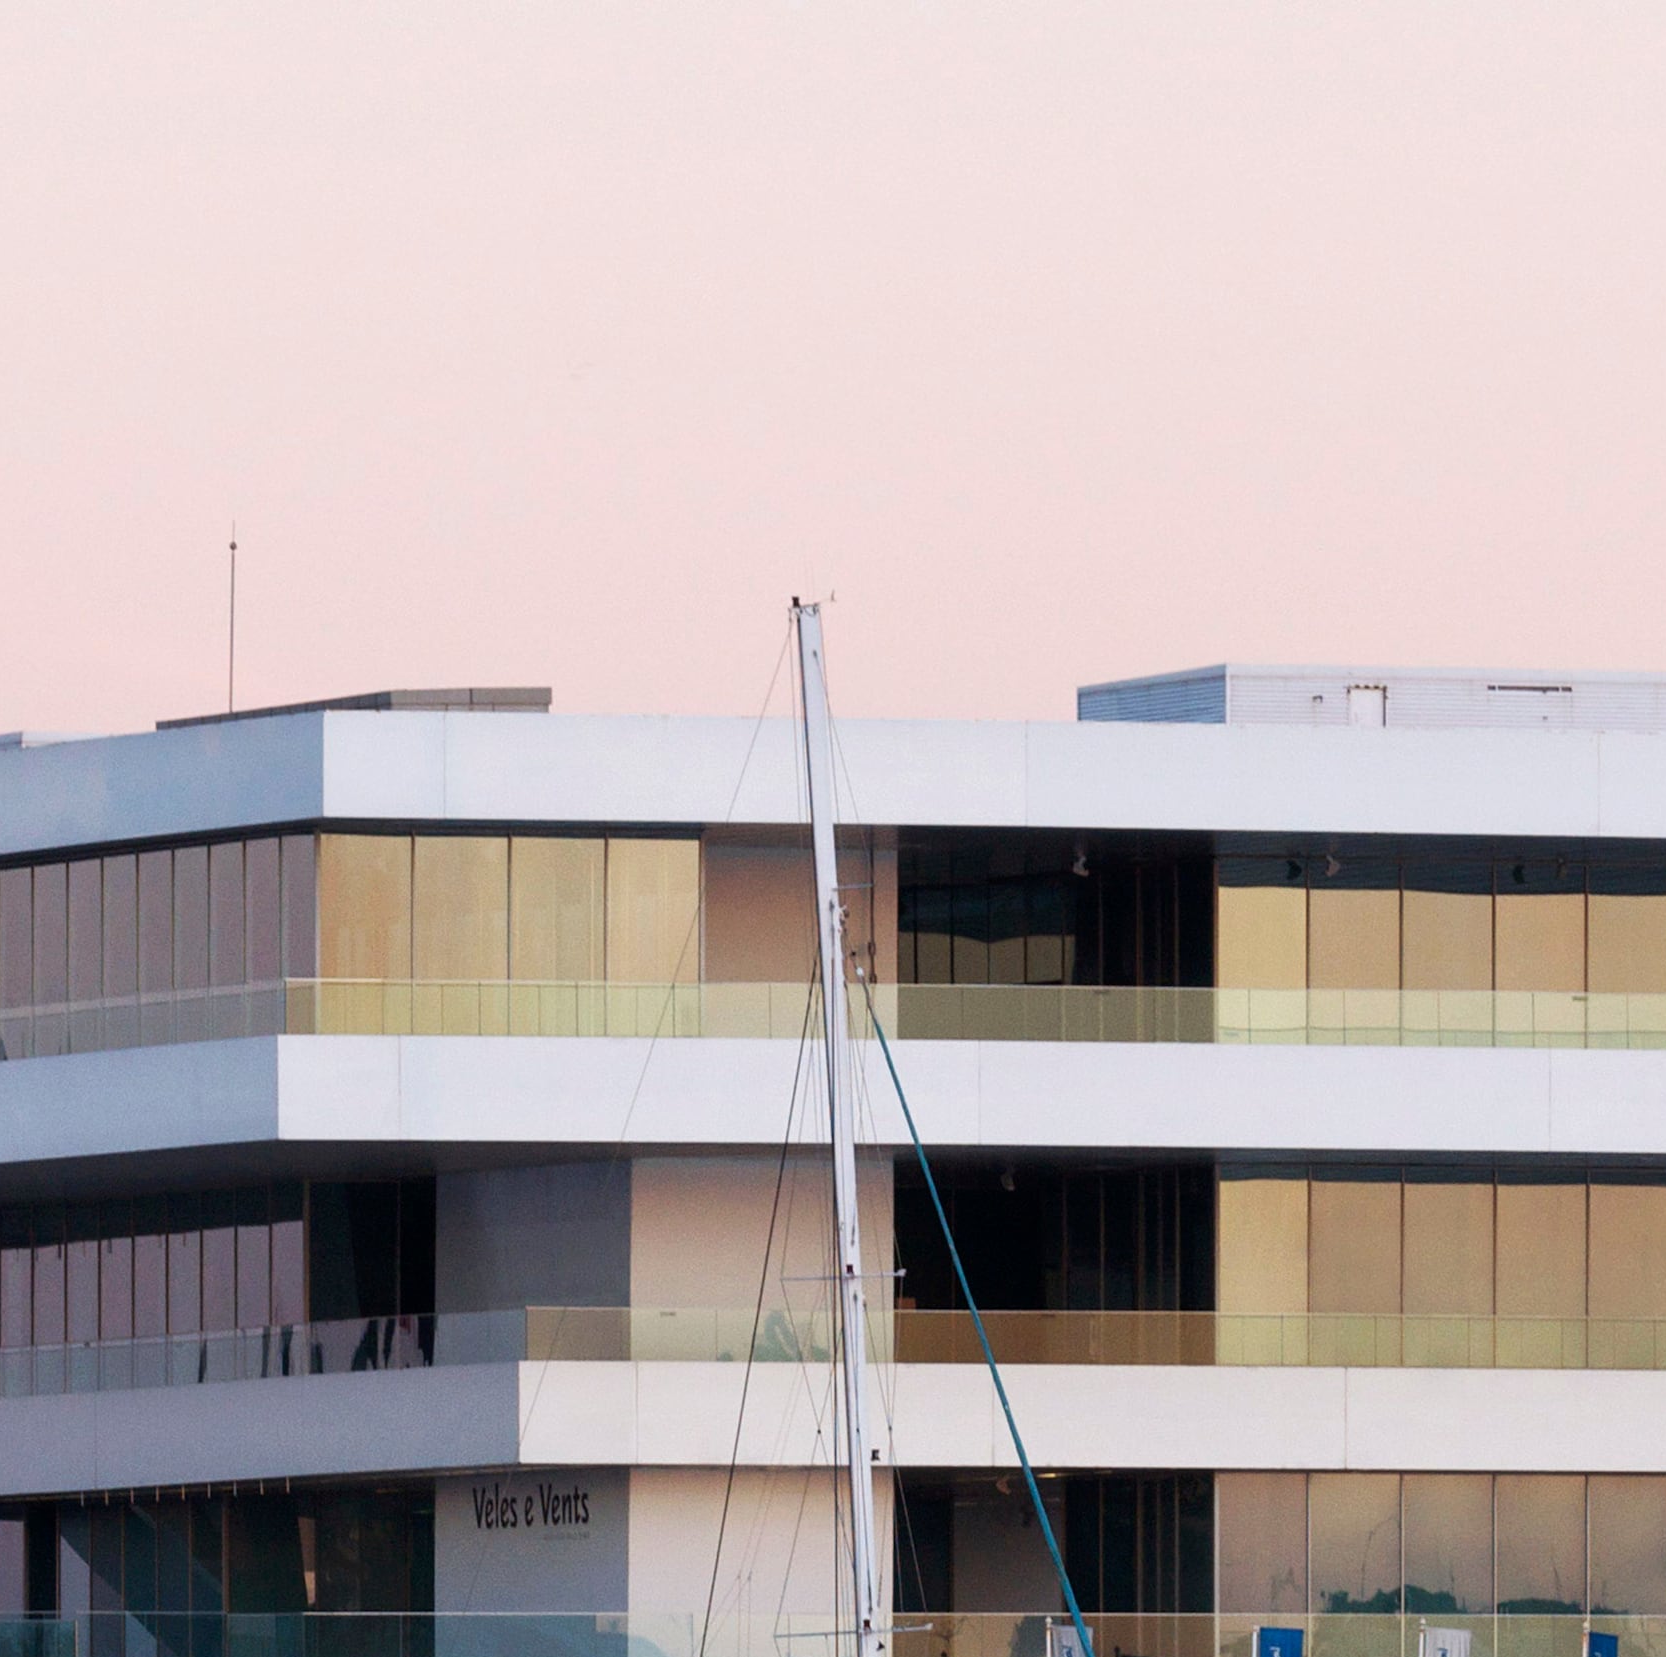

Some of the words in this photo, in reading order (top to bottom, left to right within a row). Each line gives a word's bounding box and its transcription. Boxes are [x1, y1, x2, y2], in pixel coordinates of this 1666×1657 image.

[472, 1483, 518, 1529] Veles
[524, 1495, 533, 1527] e
[539, 1483, 590, 1526] Vents
